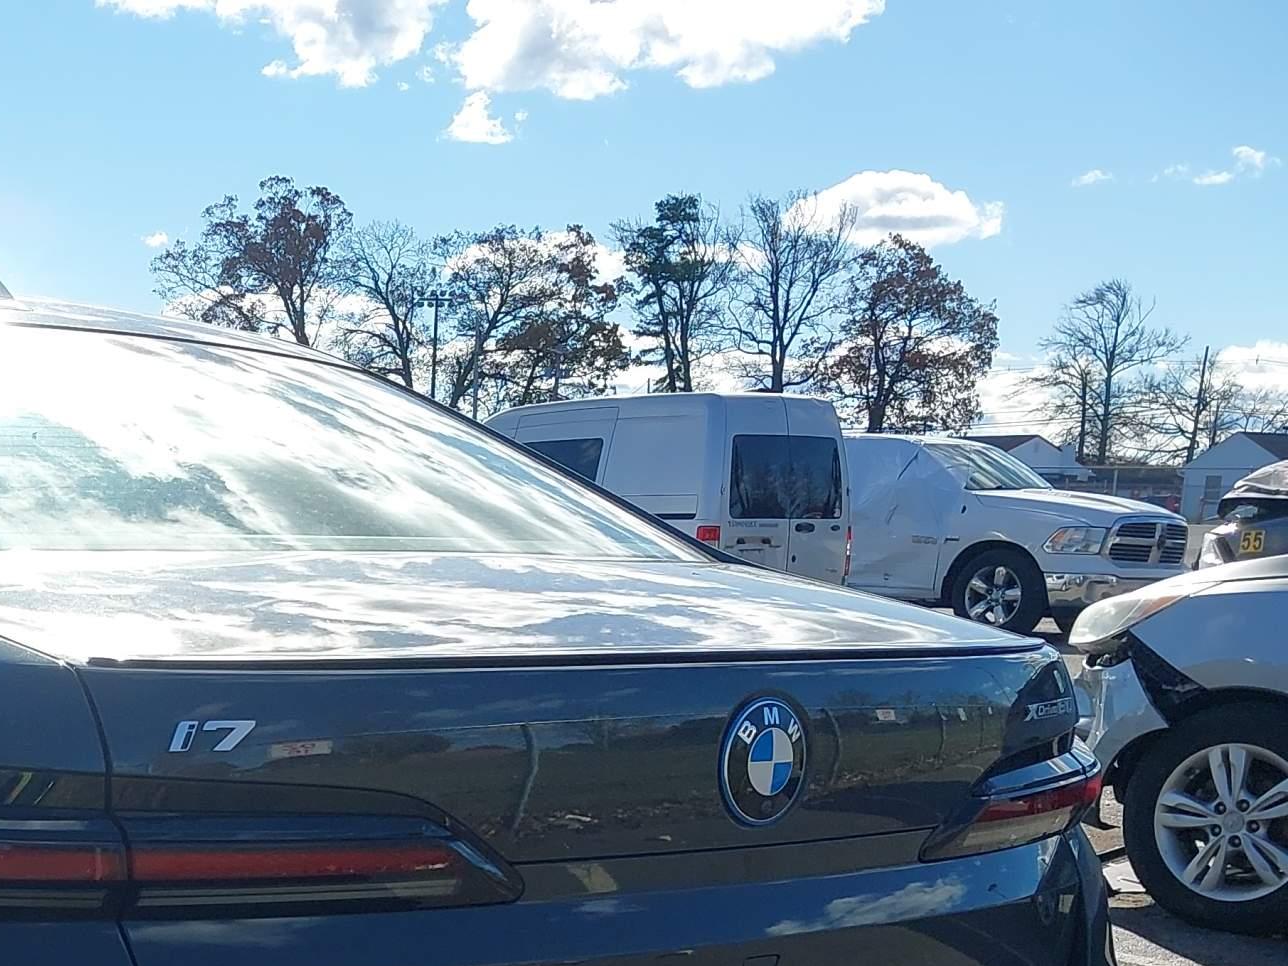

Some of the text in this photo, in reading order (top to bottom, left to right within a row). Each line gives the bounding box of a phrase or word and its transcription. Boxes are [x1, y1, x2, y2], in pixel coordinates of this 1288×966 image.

[1241, 531, 1263, 551] 55
[168, 719, 257, 752] i7
[737, 706, 801, 745] BMW
